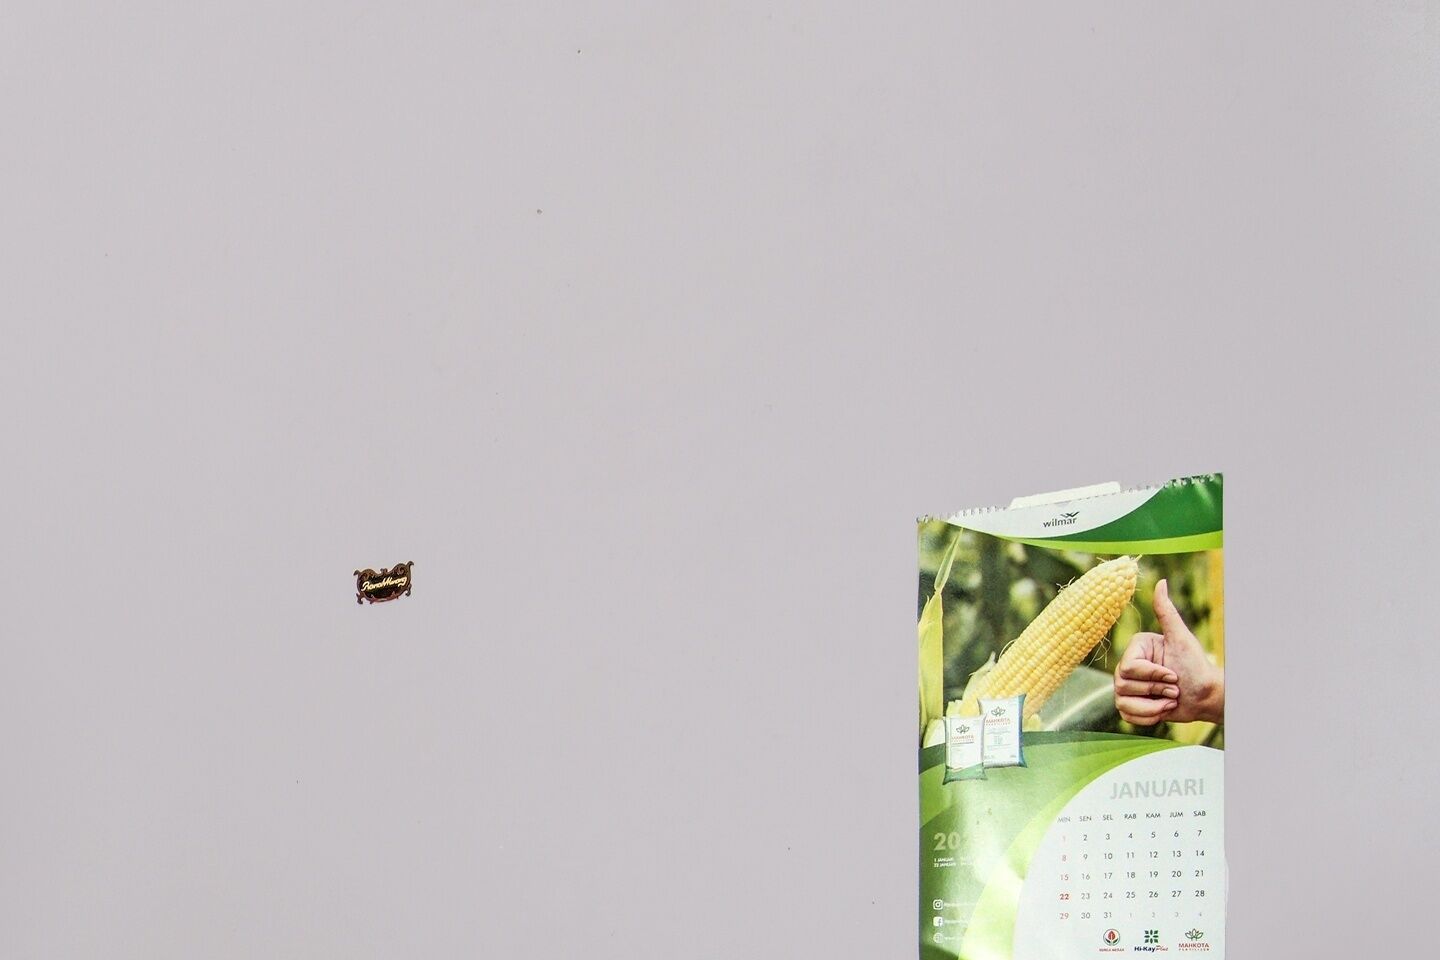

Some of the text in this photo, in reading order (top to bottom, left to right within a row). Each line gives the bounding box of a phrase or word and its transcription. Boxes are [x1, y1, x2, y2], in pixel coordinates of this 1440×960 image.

[1043, 517, 1077, 528] wilmar
[1109, 778, 1205, 799] JANUARI
[1102, 813, 1114, 821] SEL
[1123, 812, 1137, 820] RAB
[1104, 852, 1114, 860] 10
[1126, 851, 1135, 859] 11
[1149, 850, 1159, 859] 12
[1172, 850, 1182, 858] 13
[1195, 849, 1205, 857] 14
[1060, 869, 1204, 881] 15 16 17 18 19 20 21
[1059, 889, 1205, 901] 22 23 24 25 26 27 28
[1059, 912, 1070, 920] 29
[1080, 911, 1091, 920] 30
[1103, 911, 1113, 919] 31
